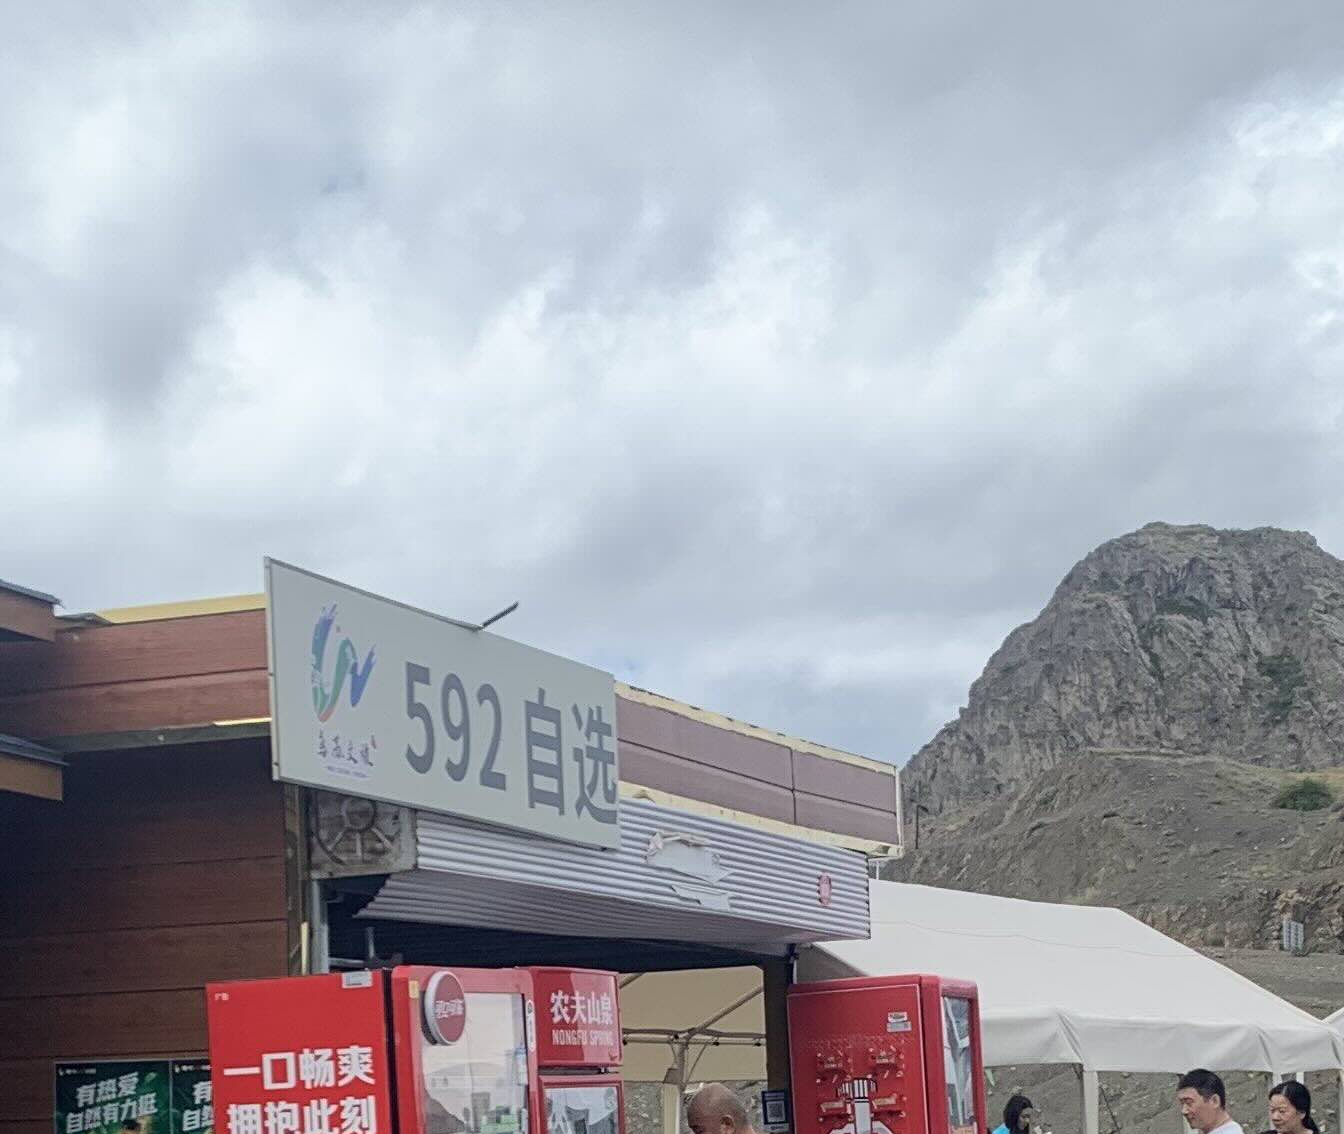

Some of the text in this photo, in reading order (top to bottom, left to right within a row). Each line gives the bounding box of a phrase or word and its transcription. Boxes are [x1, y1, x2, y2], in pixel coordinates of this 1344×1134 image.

[405, 661, 618, 824] 592自选
[550, 989, 613, 1025] 农夫山泉
[552, 1029, 587, 1046] NONGFU
[223, 1045, 376, 1091] 一口畅爽
